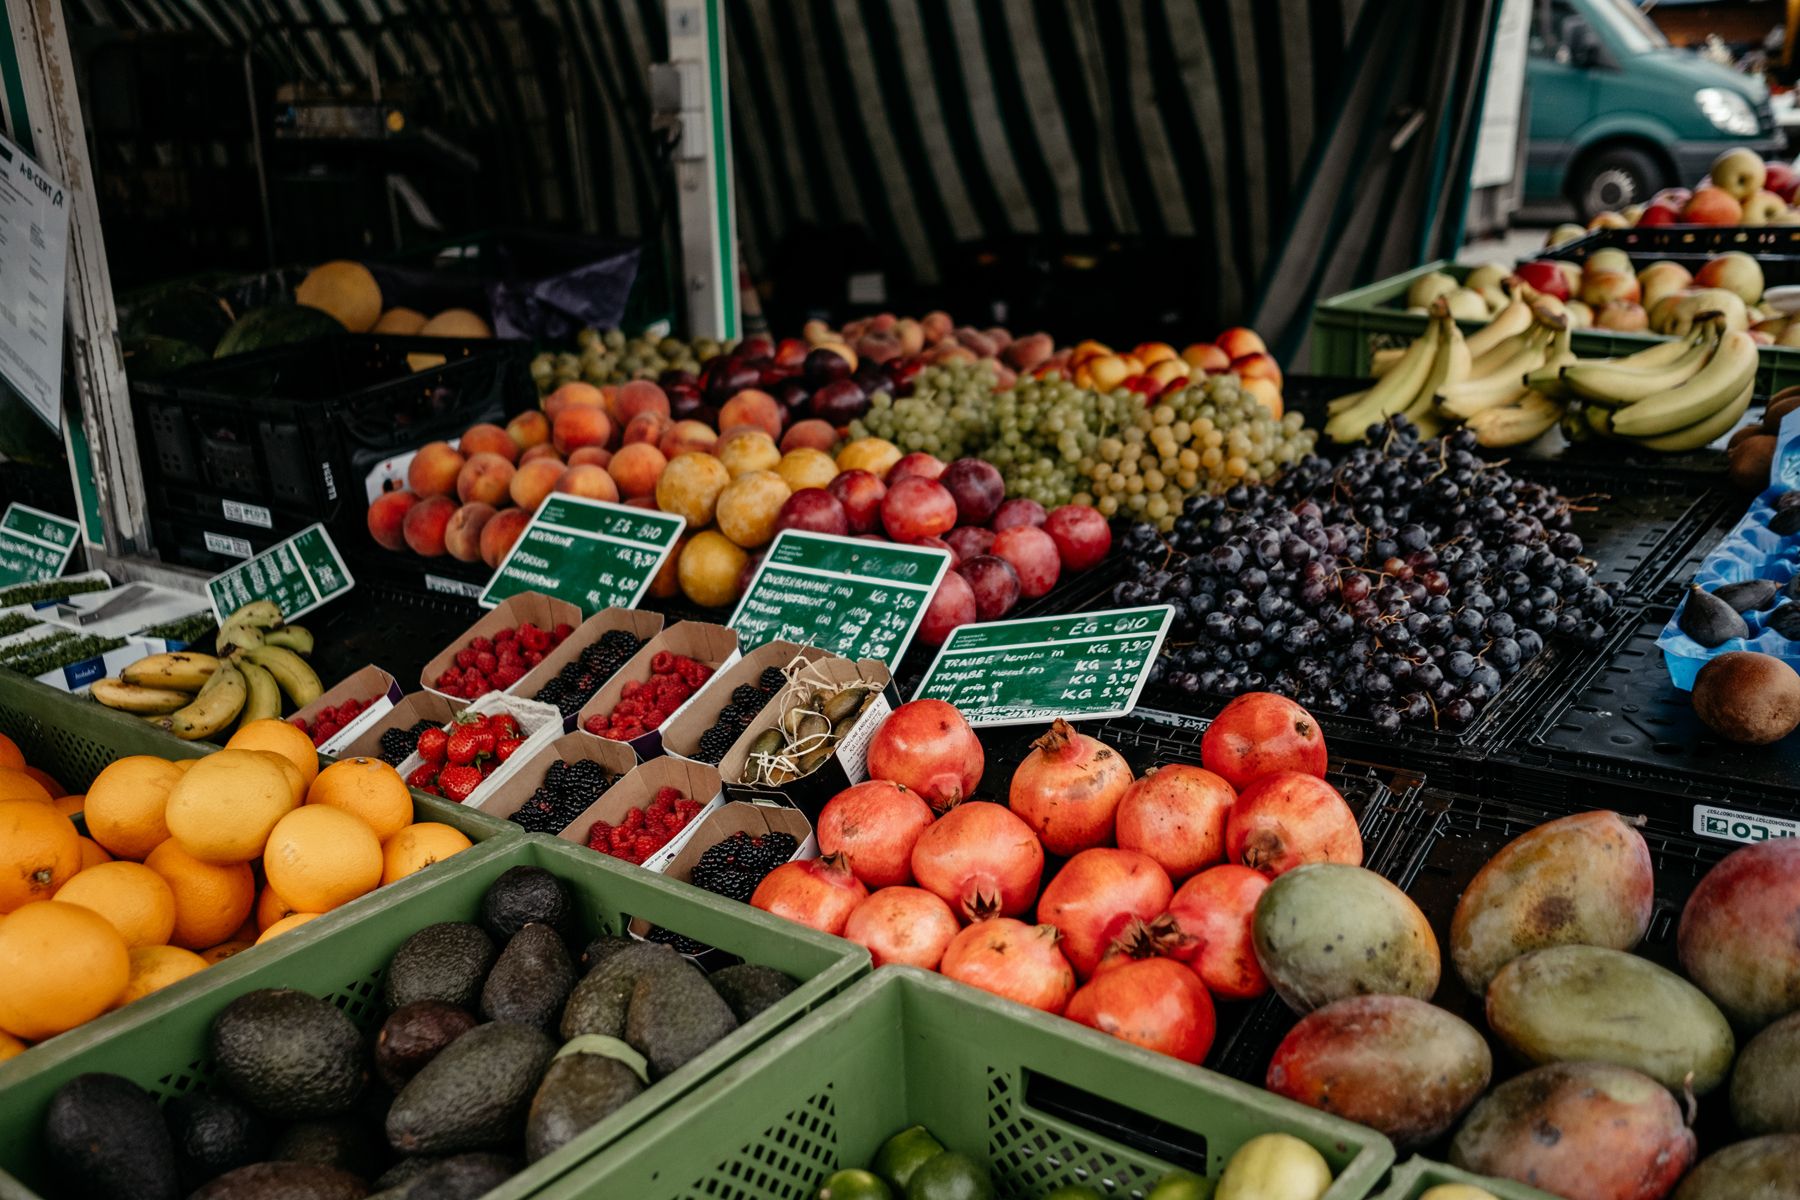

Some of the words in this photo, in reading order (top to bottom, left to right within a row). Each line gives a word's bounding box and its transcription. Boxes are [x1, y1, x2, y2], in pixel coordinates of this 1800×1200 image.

[1068, 622, 1098, 636] EG
[944, 655, 994, 669] TRAUBE
[1119, 640, 1153, 653] 7,90
[935, 669, 984, 683] TRAUBE
[1074, 660, 1100, 672] KG
[927, 684, 957, 694] KIWI
[1068, 674, 1097, 685] KG
[1061, 688, 1093, 700] KG
